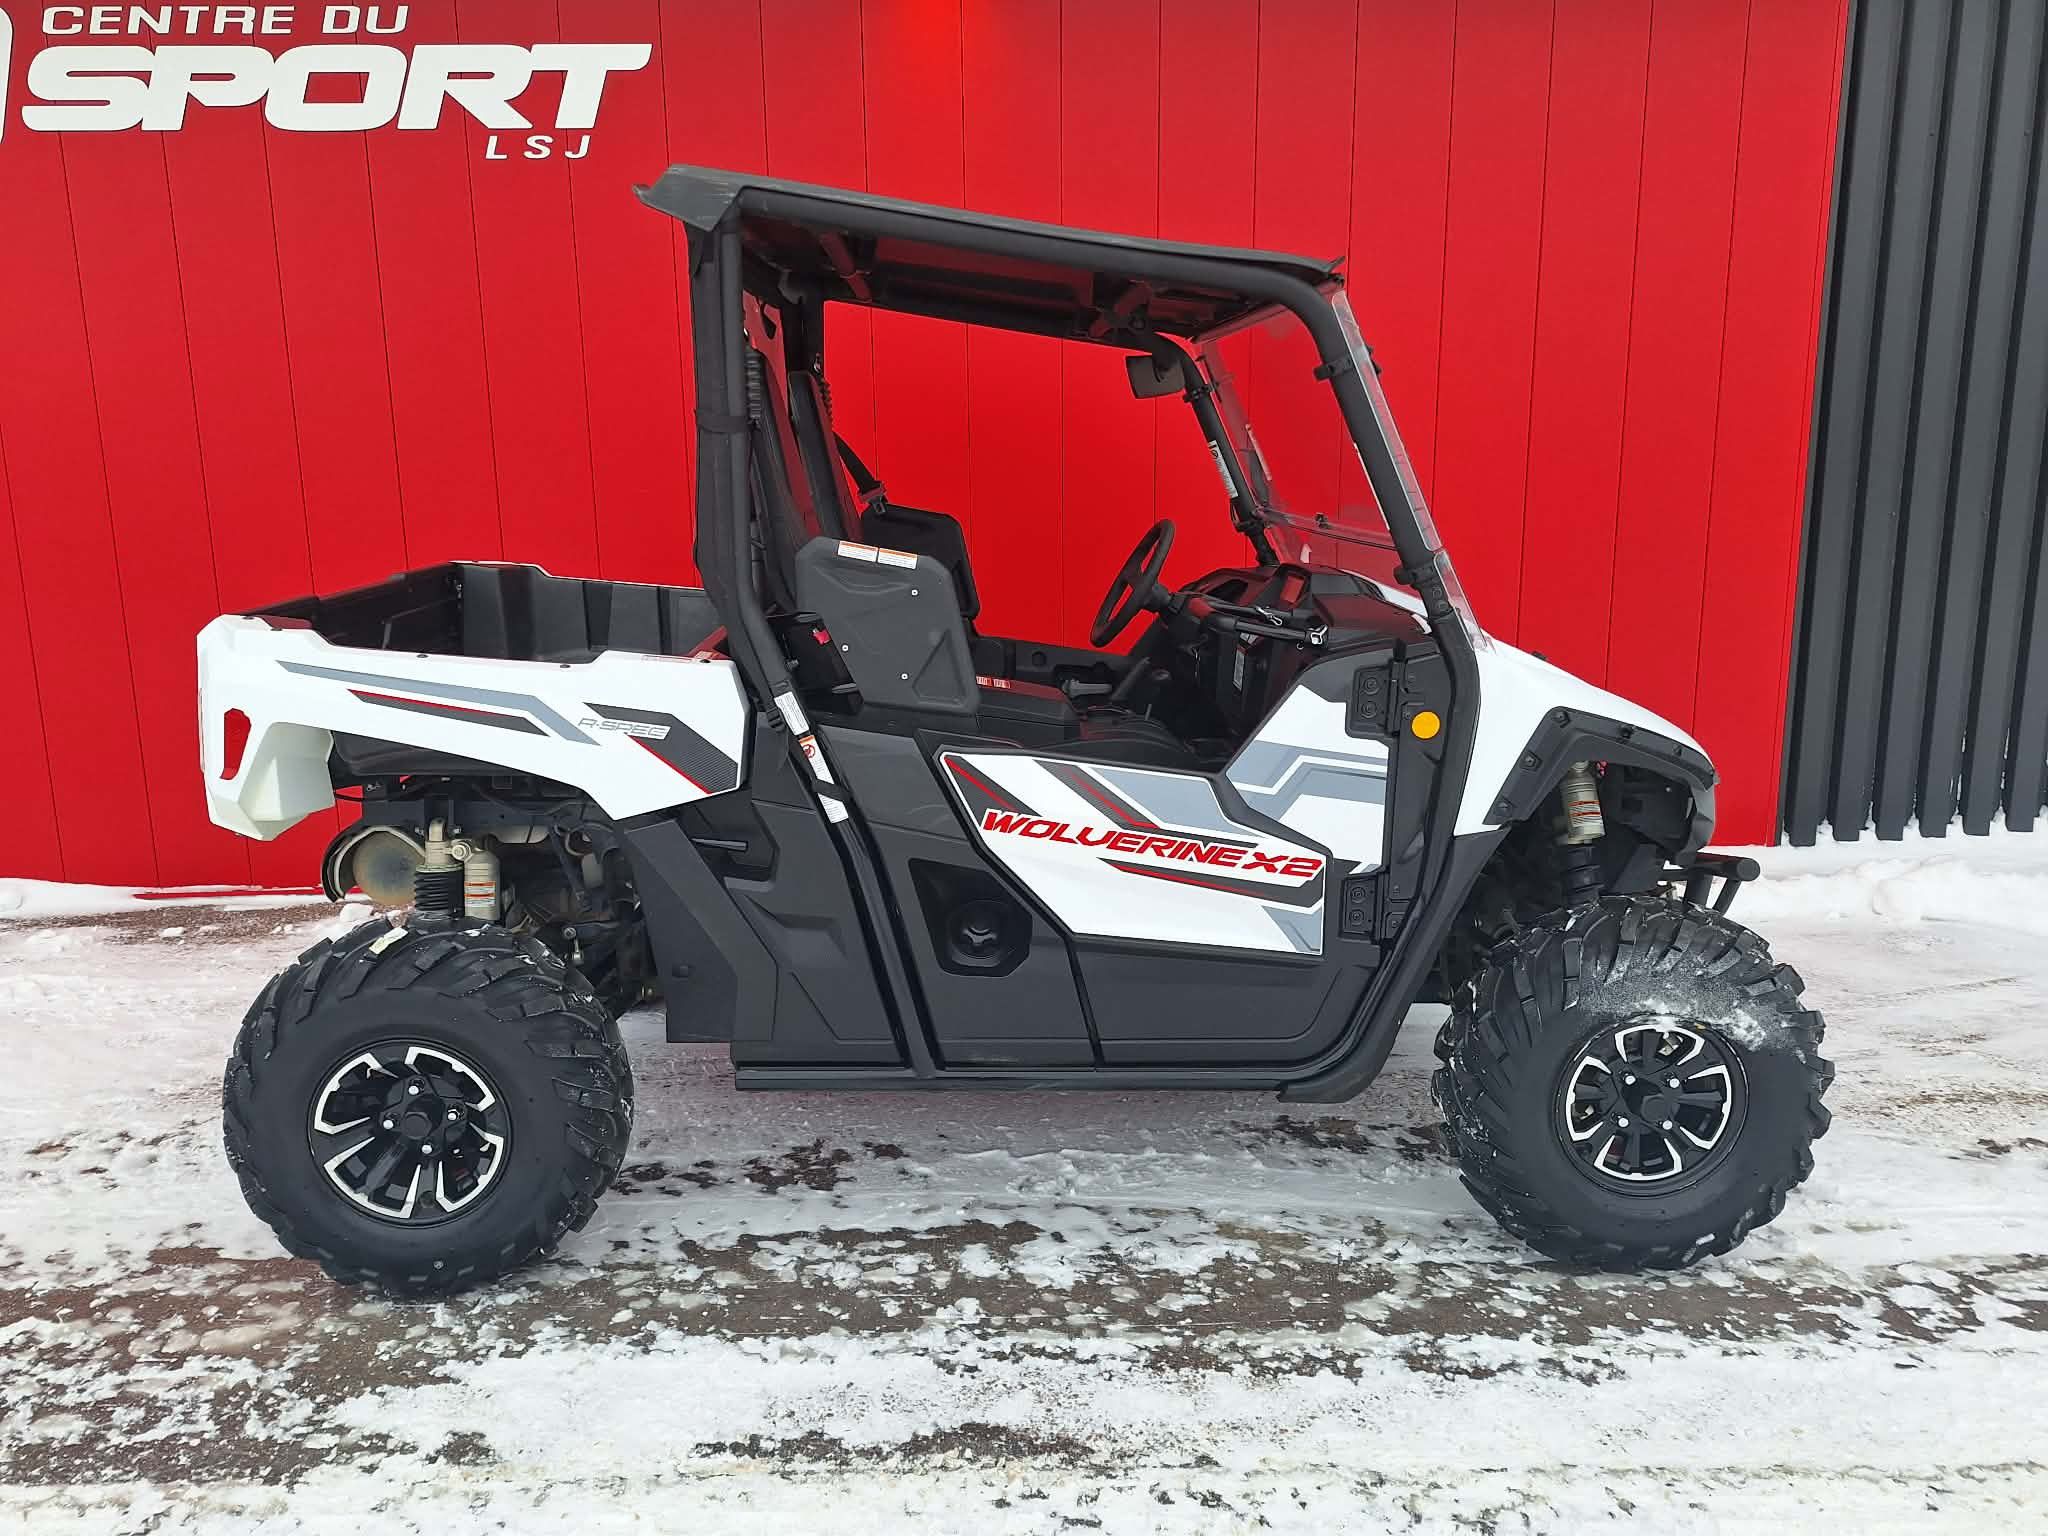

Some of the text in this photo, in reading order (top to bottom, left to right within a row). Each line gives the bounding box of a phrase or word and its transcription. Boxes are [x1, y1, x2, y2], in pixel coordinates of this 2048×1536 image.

[41, 5, 410, 36] CENTRE DU
[21, 43, 653, 132] SPORT
[982, 810, 1323, 878] WOLVERINE X2
